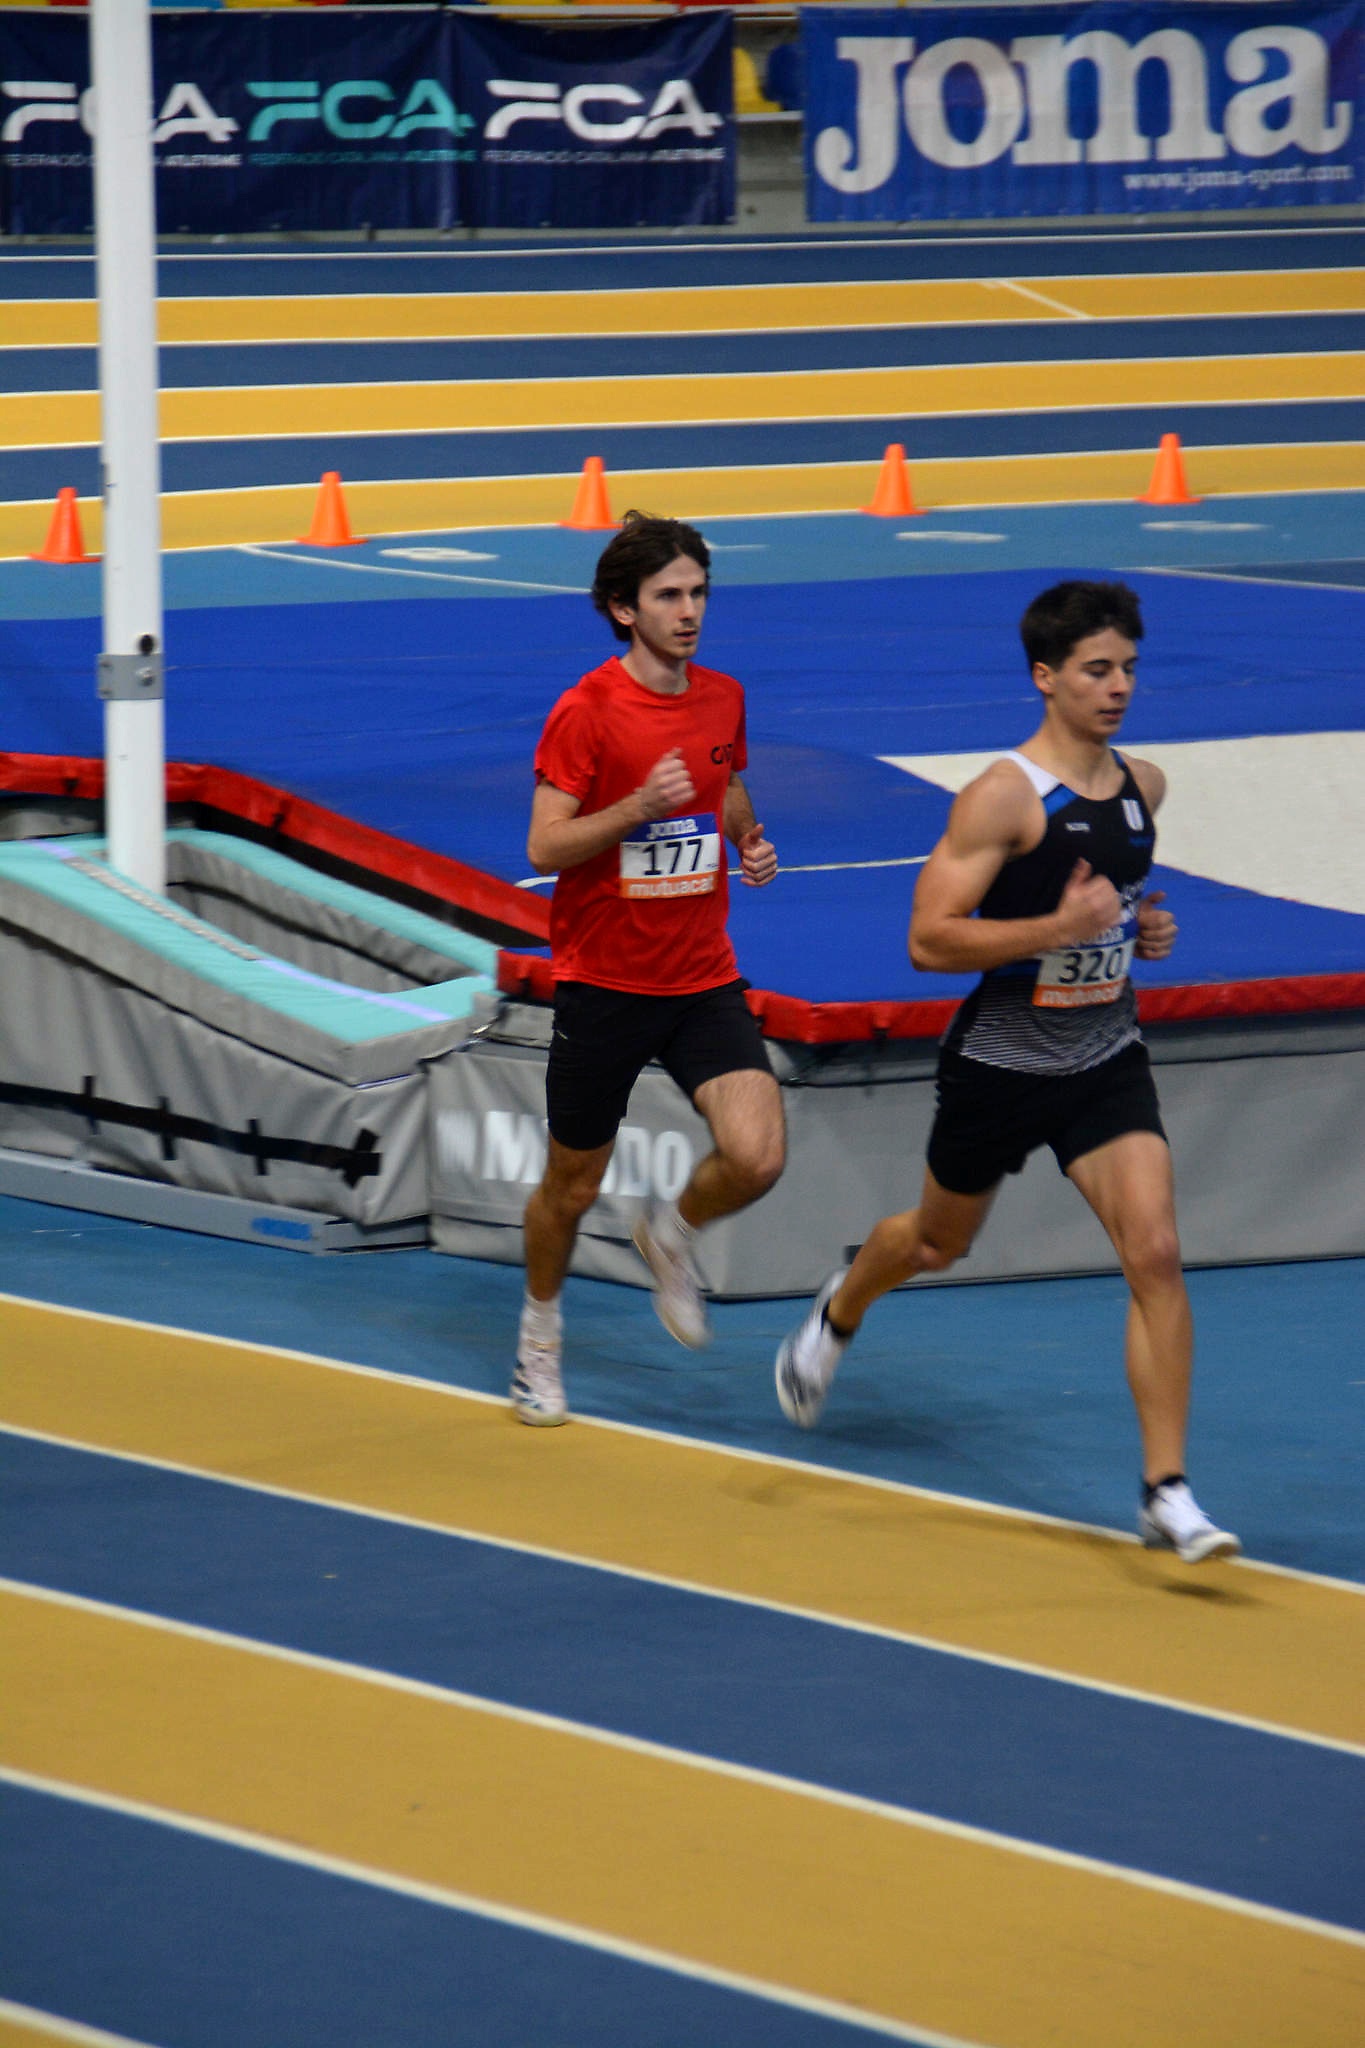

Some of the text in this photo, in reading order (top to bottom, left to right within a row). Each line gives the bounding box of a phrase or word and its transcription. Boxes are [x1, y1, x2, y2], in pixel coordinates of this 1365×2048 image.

[1, 80, 240, 142] FA
[245, 78, 477, 141] FCA
[484, 79, 725, 141] FCA
[813, 25, 1353, 194] Joma
[1123, 164, 1353, 194] www.joma-sport.com
[643, 838, 703, 876] 177
[1058, 947, 1123, 985] 320
